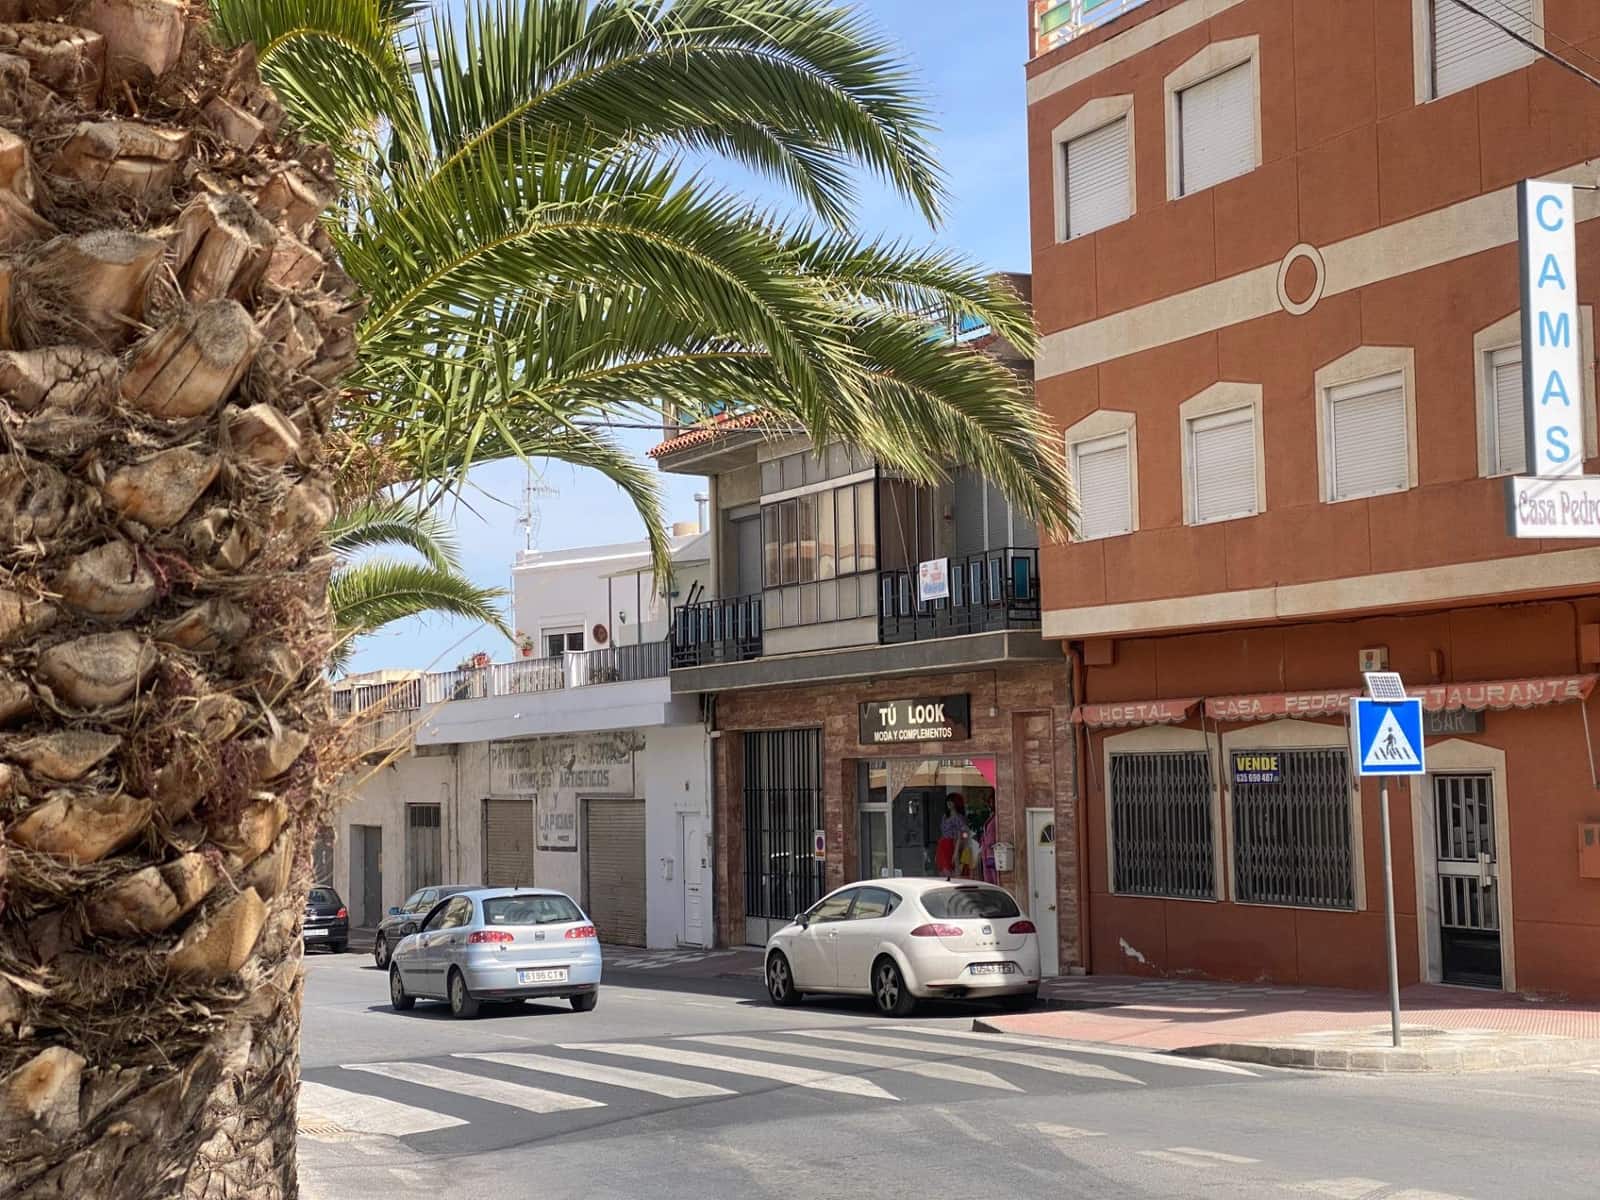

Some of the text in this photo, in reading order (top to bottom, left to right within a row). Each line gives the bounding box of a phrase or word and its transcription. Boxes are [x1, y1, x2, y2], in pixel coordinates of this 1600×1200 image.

[1535, 194, 1571, 464] CAMAS
[1519, 489, 1556, 526] Casa
[1100, 703, 1171, 721] HOSTAL
[1213, 699, 1263, 715] CASA
[1411, 680, 1580, 705] TAURANTE
[879, 703, 946, 726] TÚ LOOK
[1431, 709, 1465, 731] BAR
[874, 727, 953, 742] MODA Y COMPLEMENTOS
[1236, 756, 1278, 771] VENDE
